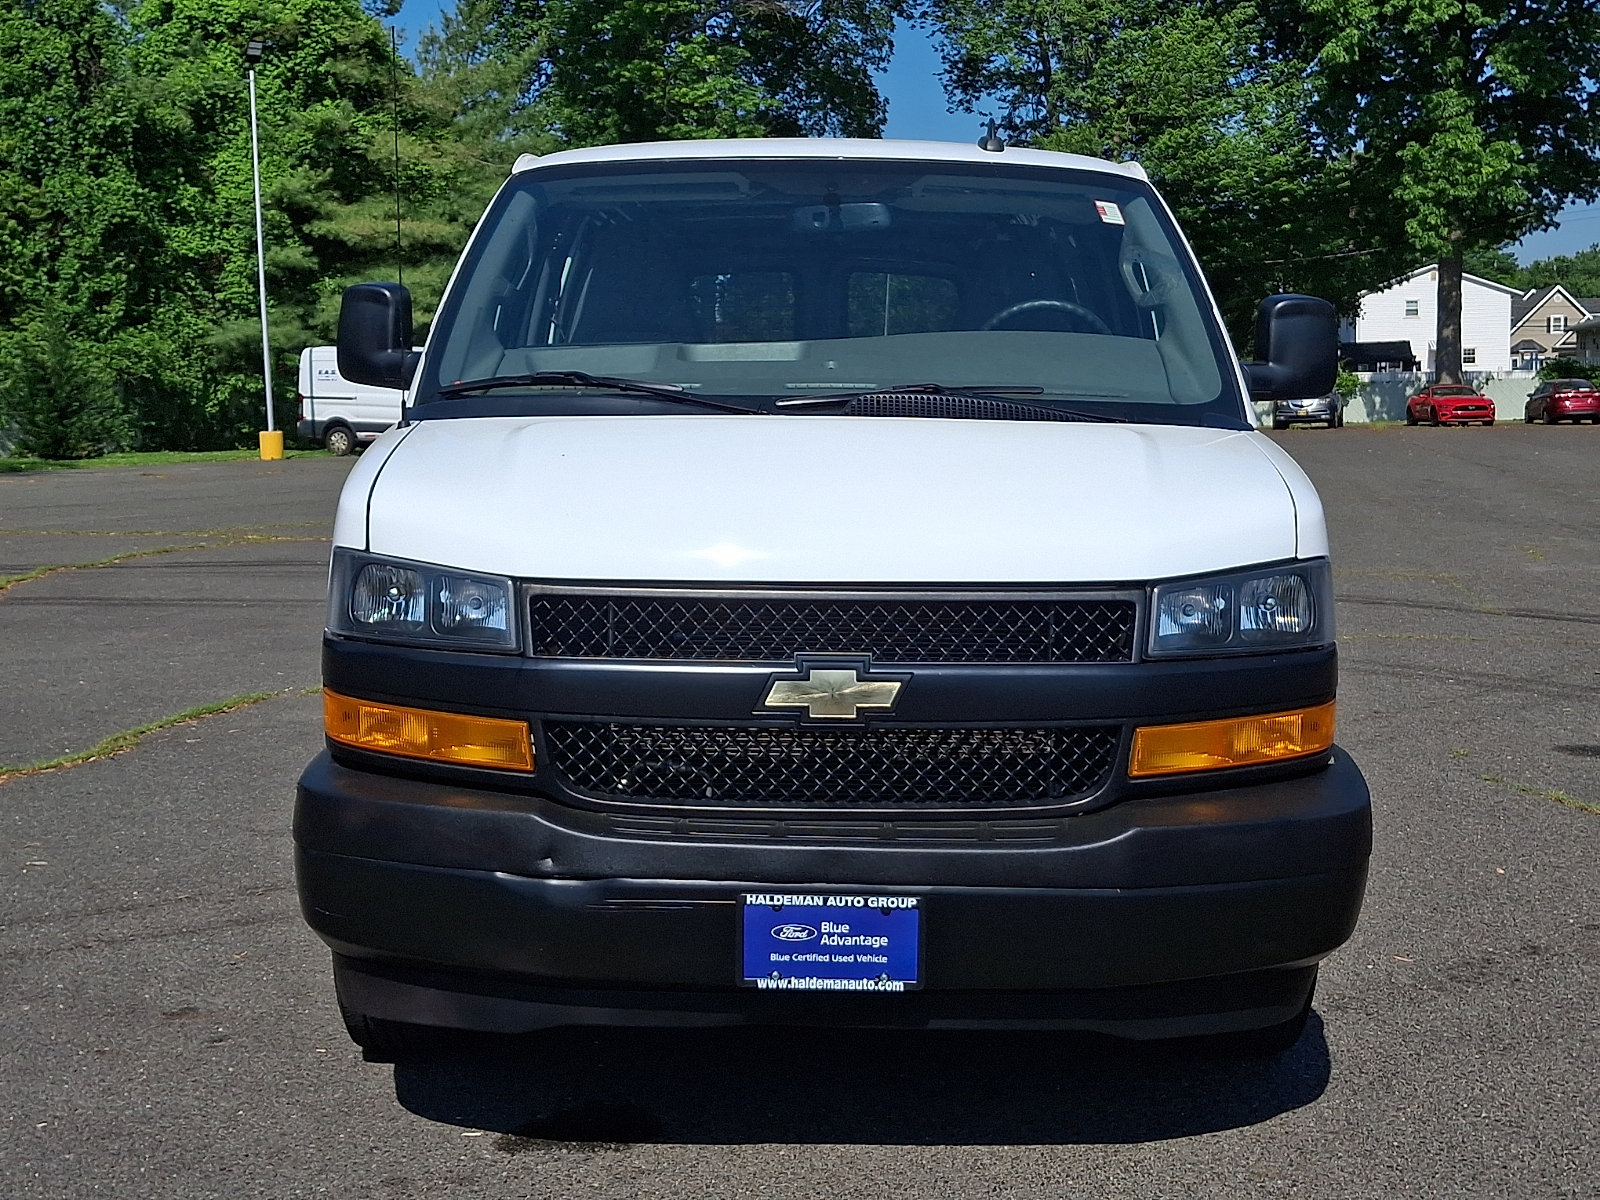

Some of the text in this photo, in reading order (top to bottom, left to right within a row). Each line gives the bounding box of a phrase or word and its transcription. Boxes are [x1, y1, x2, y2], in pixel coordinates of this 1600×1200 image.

[746, 894, 917, 908] HALDEMAN AUTO GROUP
[780, 926, 809, 938] Ford
[821, 922, 850, 933] Blue
[820, 934, 889, 948] Advantage
[770, 953, 888, 963] Blue Certified Used Vehicle
[757, 977, 904, 992] www.haldemanauto.com
